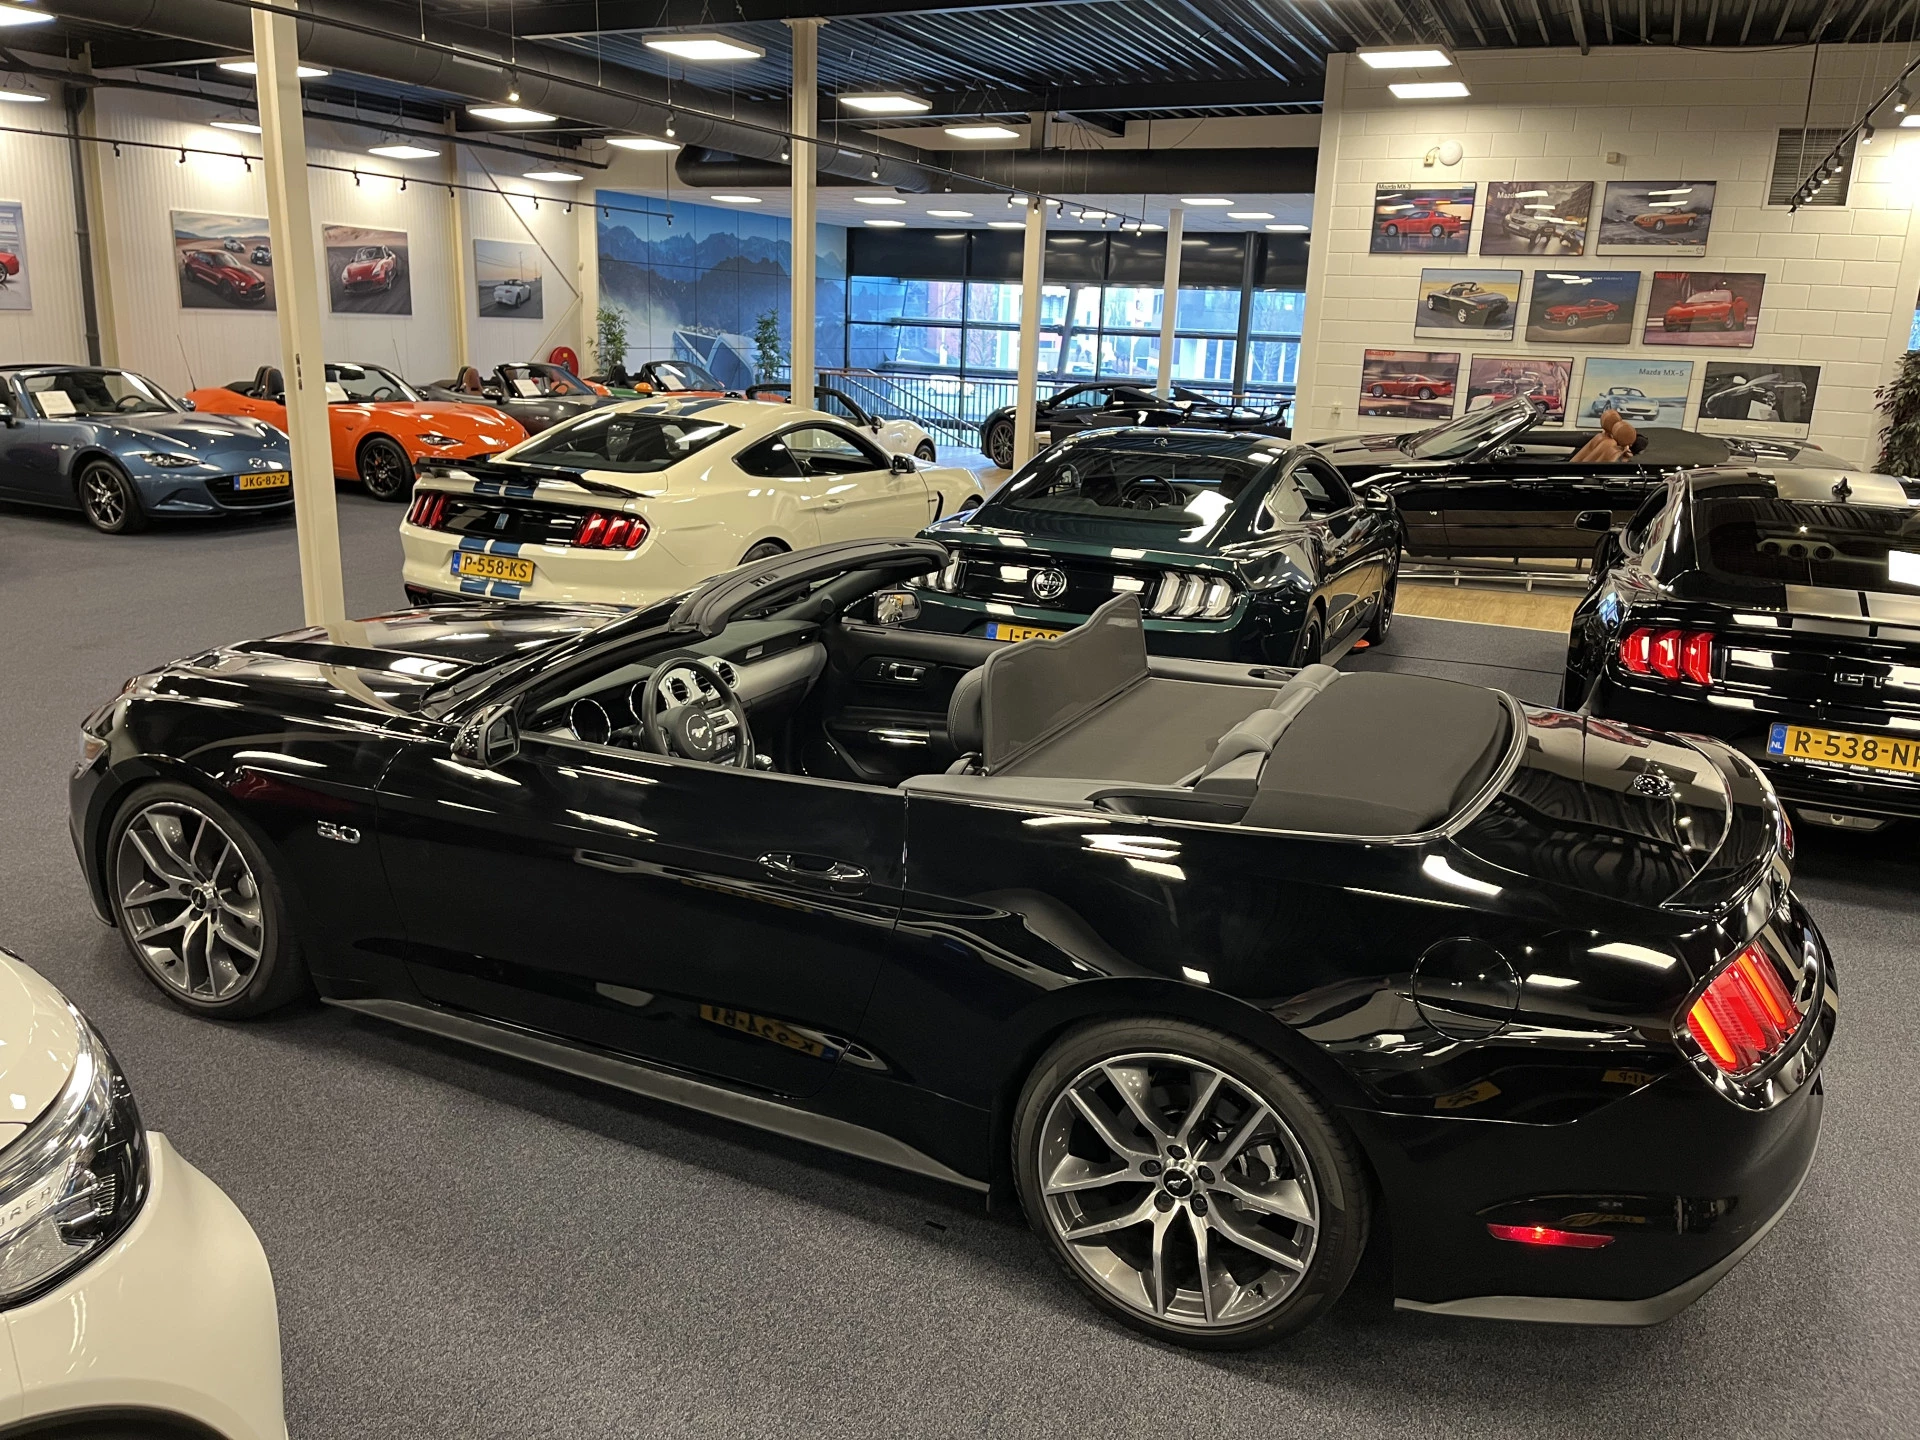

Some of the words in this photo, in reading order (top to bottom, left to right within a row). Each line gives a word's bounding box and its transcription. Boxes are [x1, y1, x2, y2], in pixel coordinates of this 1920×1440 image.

[1638, 368, 1661, 376] Mazda
[1663, 369, 1685, 377] MX-5
[243, 474, 285, 488] JKG-82-Z
[464, 556, 528, 578] P-558-KS
[1770, 740, 1783, 750] NL
[317, 820, 360, 844] 5.0
